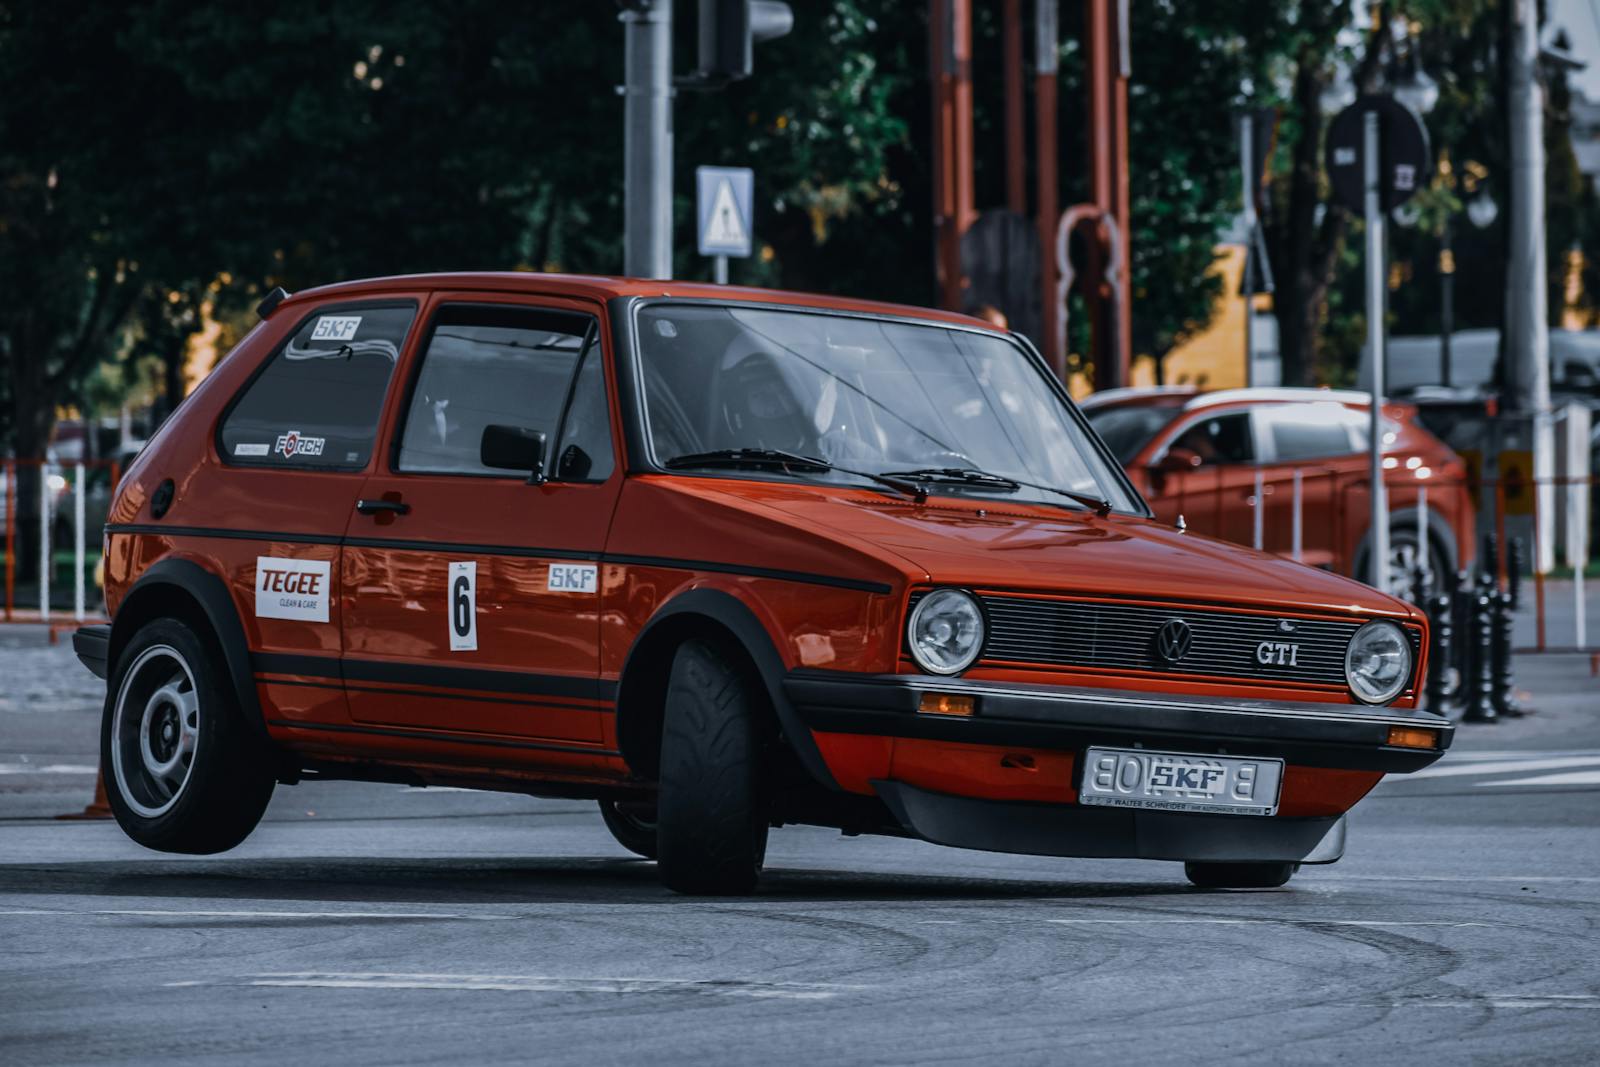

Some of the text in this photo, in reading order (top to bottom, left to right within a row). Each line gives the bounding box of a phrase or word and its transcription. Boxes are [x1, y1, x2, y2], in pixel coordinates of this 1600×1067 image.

[314, 320, 358, 337] SKF
[262, 569, 324, 595] TEGEE
[550, 567, 595, 589] SKF
[279, 598, 297, 607] CLEAN
[302, 600, 317, 609] CARE
[453, 575, 471, 637] 6
[1256, 641, 1299, 666] GTI
[1151, 766, 1224, 790] SKF
[1114, 799, 1186, 811] WALTER SCHNEIDER
